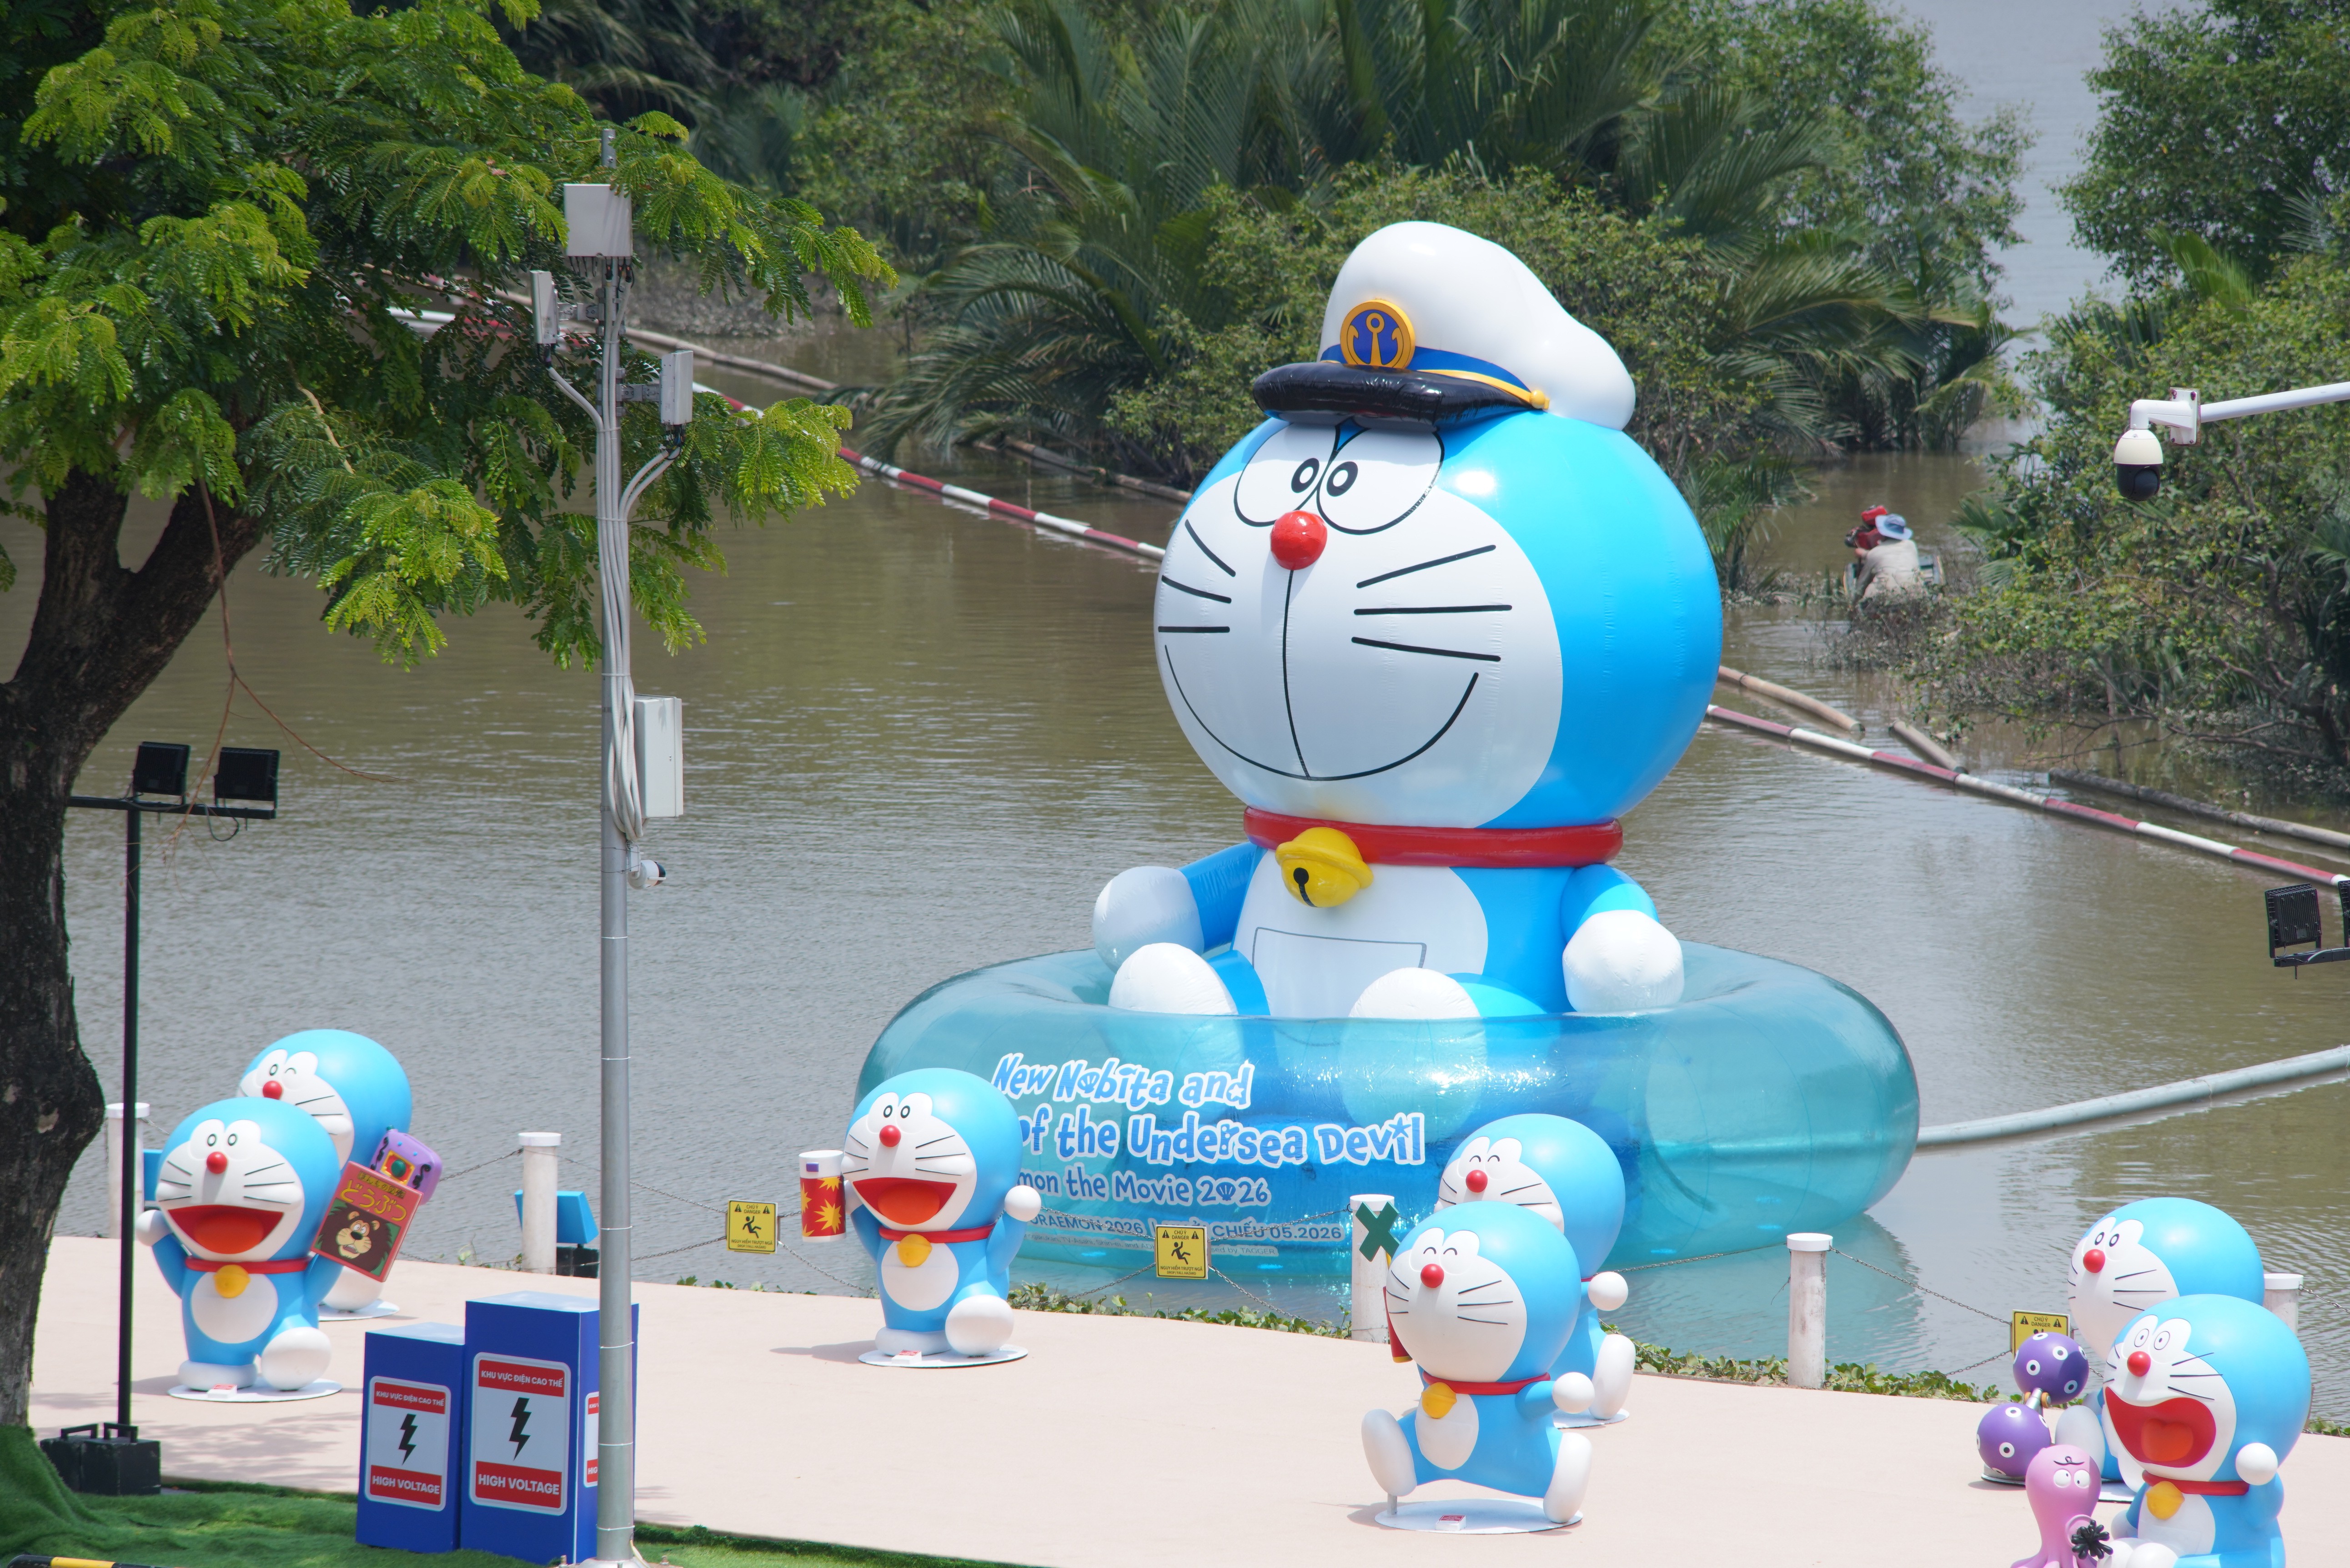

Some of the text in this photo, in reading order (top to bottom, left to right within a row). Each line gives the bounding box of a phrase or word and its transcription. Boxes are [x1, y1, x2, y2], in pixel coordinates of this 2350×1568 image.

[993, 1055, 1251, 1108] New Nobita and
[1057, 1107, 1116, 1158] the
[1130, 1114, 1303, 1164] Undersea
[1317, 1116, 1421, 1161] Devil
[1066, 1166, 1106, 1198] the
[1115, 1174, 1190, 1202] Movie
[1200, 1181, 1268, 1203] 2026
[340, 1179, 407, 1221] どうぶつ
[1105, 1220, 1143, 1234] 2026
[1212, 1220, 1265, 1238] CHIẾU
[1270, 1226, 1342, 1239] 05.2026
[481, 1370, 564, 1387] KHU VỰC ĐIỆN CAO THẾ
[390, 1392, 403, 1402] VỰC
[403, 1394, 417, 1403] ĐIỆN
[432, 1397, 445, 1406] THẾ
[588, 1466, 598, 1475] HIG
[372, 1475, 440, 1494] HIGH VOLTAGE
[478, 1473, 560, 1495] HIGH VOLTAGE
